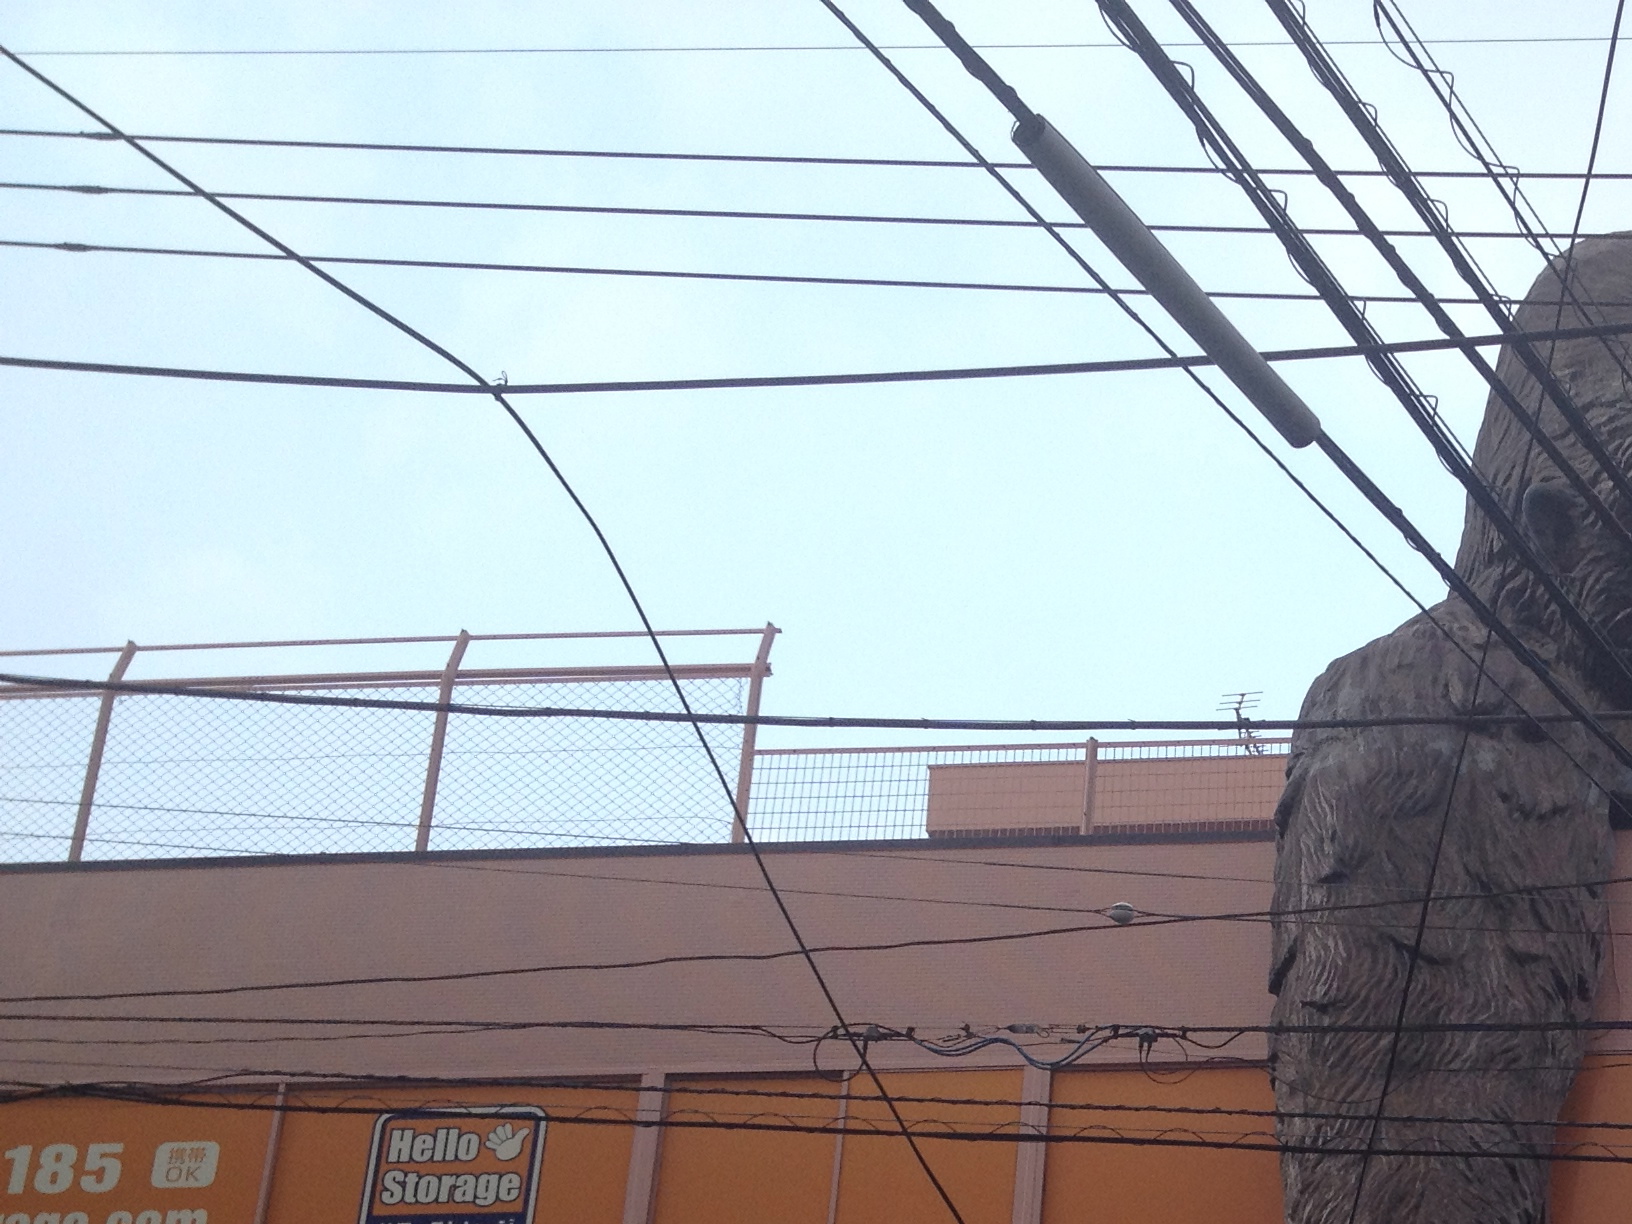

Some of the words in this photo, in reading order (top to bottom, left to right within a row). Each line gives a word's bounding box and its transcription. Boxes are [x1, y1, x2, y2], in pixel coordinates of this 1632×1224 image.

[387, 1127, 479, 1165] Hello
[2, 1142, 125, 1195] 185
[165, 1165, 202, 1183] OK
[380, 1169, 521, 1209] Storage
